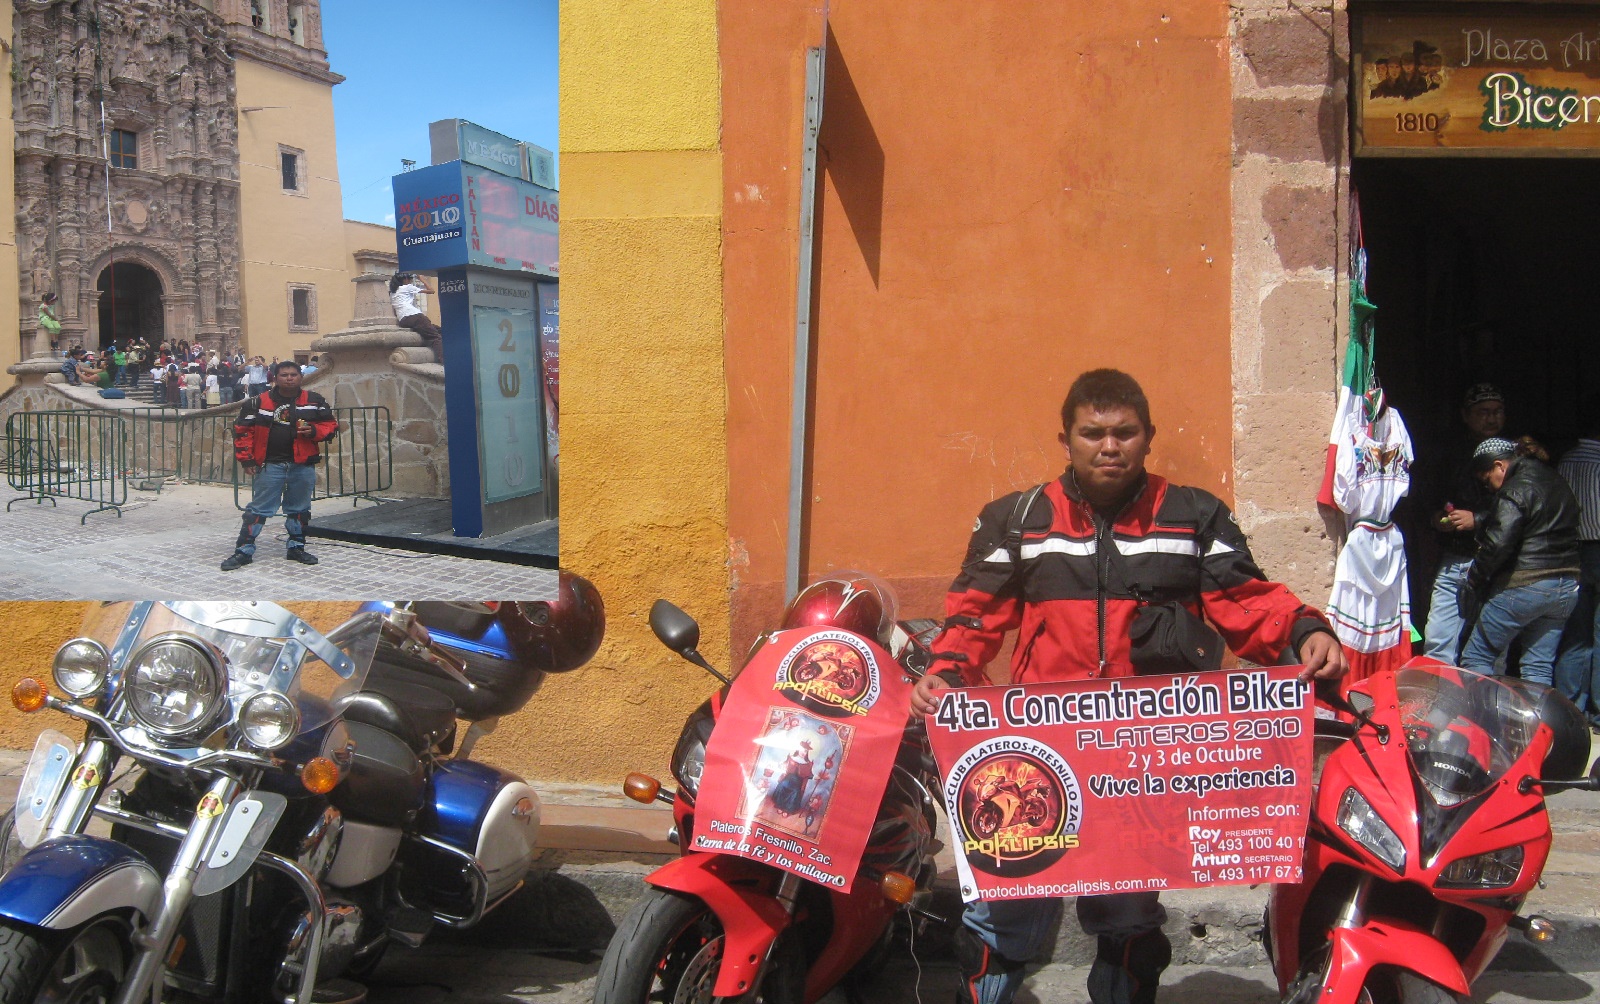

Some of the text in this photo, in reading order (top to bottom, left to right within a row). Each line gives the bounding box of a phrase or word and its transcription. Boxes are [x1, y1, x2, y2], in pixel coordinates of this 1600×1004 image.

[1461, 28, 1600, 68] Plaza Ar
[1486, 72, 1600, 127] Bicen
[1395, 112, 1440, 133] 1810
[400, 193, 459, 214] MÉXICO
[466, 175, 480, 251] FALTAN
[525, 194, 559, 223] DÍAS
[400, 206, 460, 232] 2010
[403, 231, 460, 247] Guanajuato
[440, 283, 466, 294] 2010
[778, 641, 808, 682] MOTO-CLUB
[810, 633, 878, 693] PLATEROS-FRESNILLO
[772, 680, 869, 717] APOKLIPSIS
[935, 670, 1310, 732] 4ta. Concentración Biker
[1076, 717, 1302, 751] PLATEROS 2010
[1127, 744, 1262, 771] 2 y 3 de Octubre
[1433, 761, 1472, 779] HONDA
[965, 740, 1078, 802] PLATEROS-FRESNILLO
[1065, 803, 1079, 833] ZAC.
[1088, 764, 1296, 799] Vive la experiencia
[1187, 804, 1300, 821] Informes con:
[710, 820, 833, 867] Plateros Fresnillo, Zac.
[1188, 825, 1221, 843] Roy
[1225, 828, 1274, 838] PRESIDENTE
[1190, 840, 1214, 854] Tel.
[1217, 838, 1243, 852] 493
[1248, 836, 1272, 850] 100
[1275, 836, 1293, 849] 40
[724, 838, 736, 851] de
[737, 840, 751, 853] la
[752, 846, 766, 858] fé
[764, 851, 775, 863] y
[776, 853, 794, 868] los
[964, 833, 1080, 867] POKLIPSIS
[1192, 853, 1293, 868] Arturo SECRETARIO
[1191, 869, 1215, 883] Tel.
[1218, 867, 1244, 881] 493
[1249, 865, 1271, 879] 117
[1275, 865, 1292, 878] 67
[979, 878, 1168, 899] motoclubapocalipsis.com.mx
